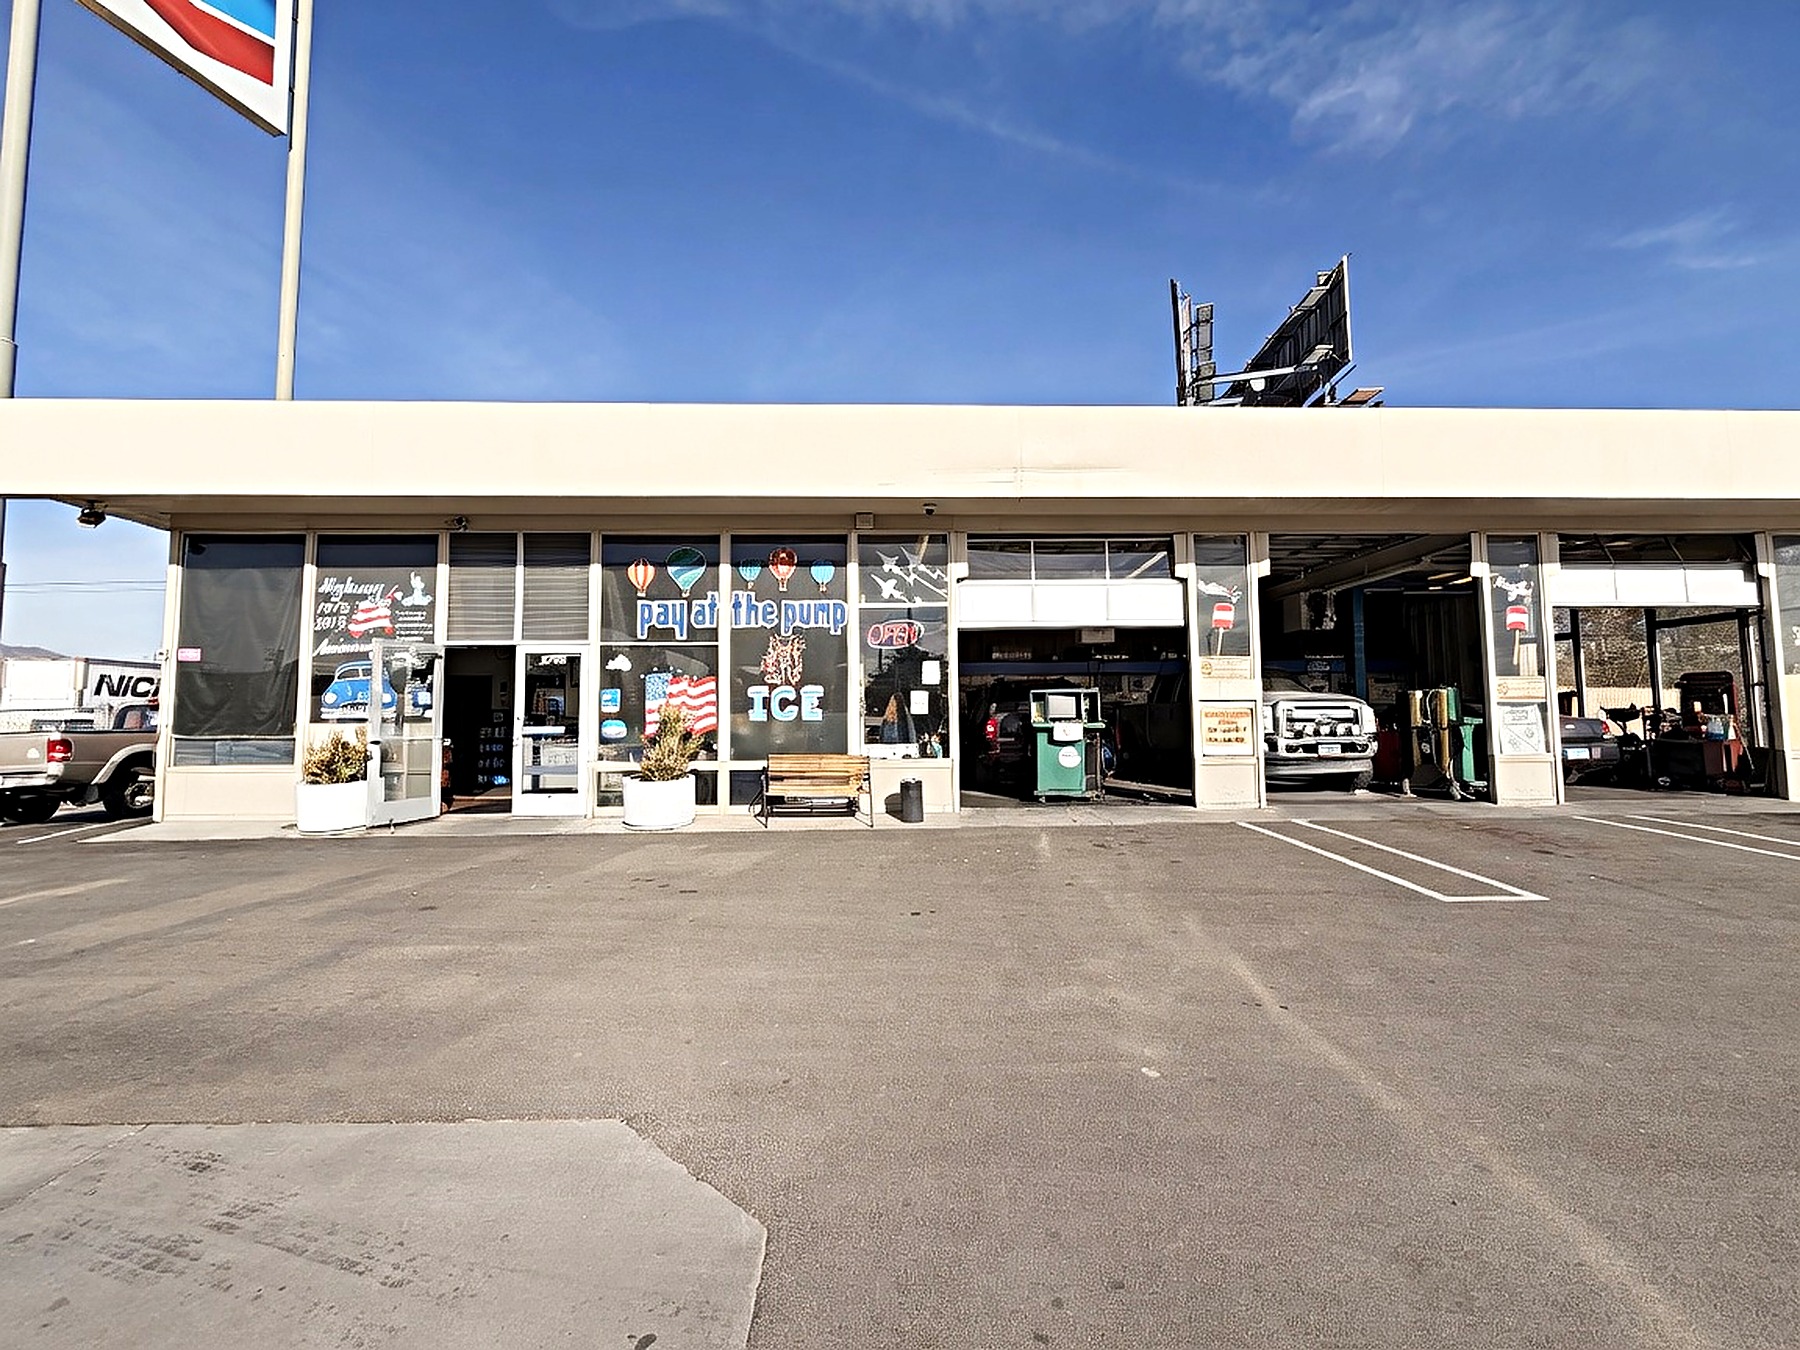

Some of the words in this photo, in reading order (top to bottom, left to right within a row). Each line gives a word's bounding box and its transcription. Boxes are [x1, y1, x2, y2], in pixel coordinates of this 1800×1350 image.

[637, 600, 688, 640] pay
[691, 591, 719, 628] at
[732, 591, 779, 629] the
[781, 600, 849, 637] pump
[868, 622, 919, 646] OPEN
[747, 684, 825, 723] ICE
